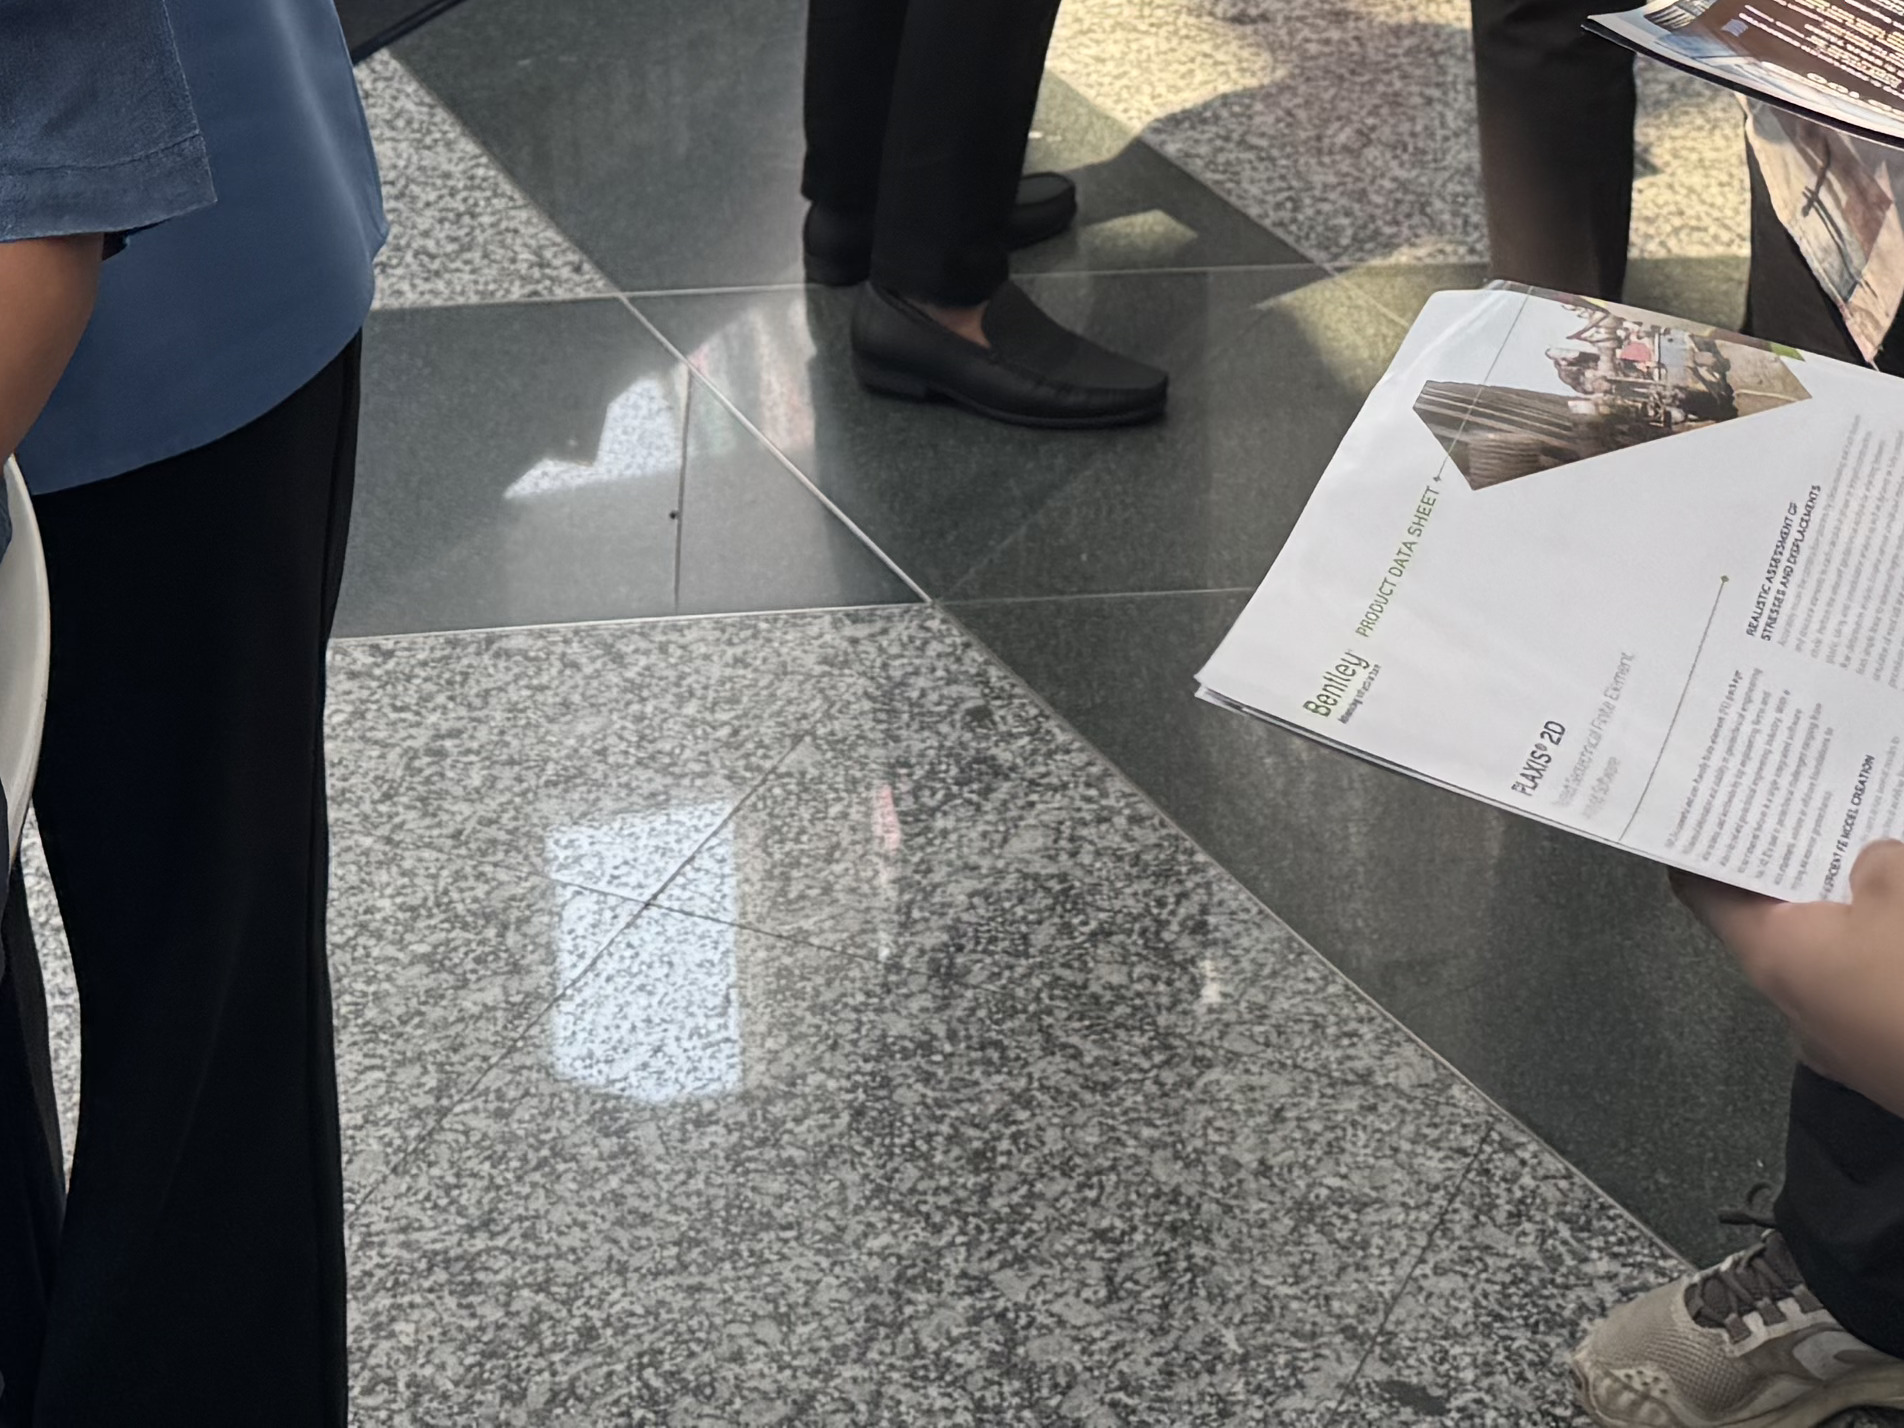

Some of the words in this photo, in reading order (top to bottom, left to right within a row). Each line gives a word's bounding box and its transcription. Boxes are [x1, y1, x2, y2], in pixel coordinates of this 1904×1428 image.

[1303, 650, 1370, 718] Bentley
[1354, 575, 1398, 640] PRODUCT
[1386, 536, 1418, 578] DATA
[1406, 484, 1440, 538] SHEET
[1777, 563, 1796, 589] AND
[1744, 583, 1773, 637] REALISTIC
[1538, 718, 1567, 746] 2D
[1850, 754, 1875, 806] CREATION
